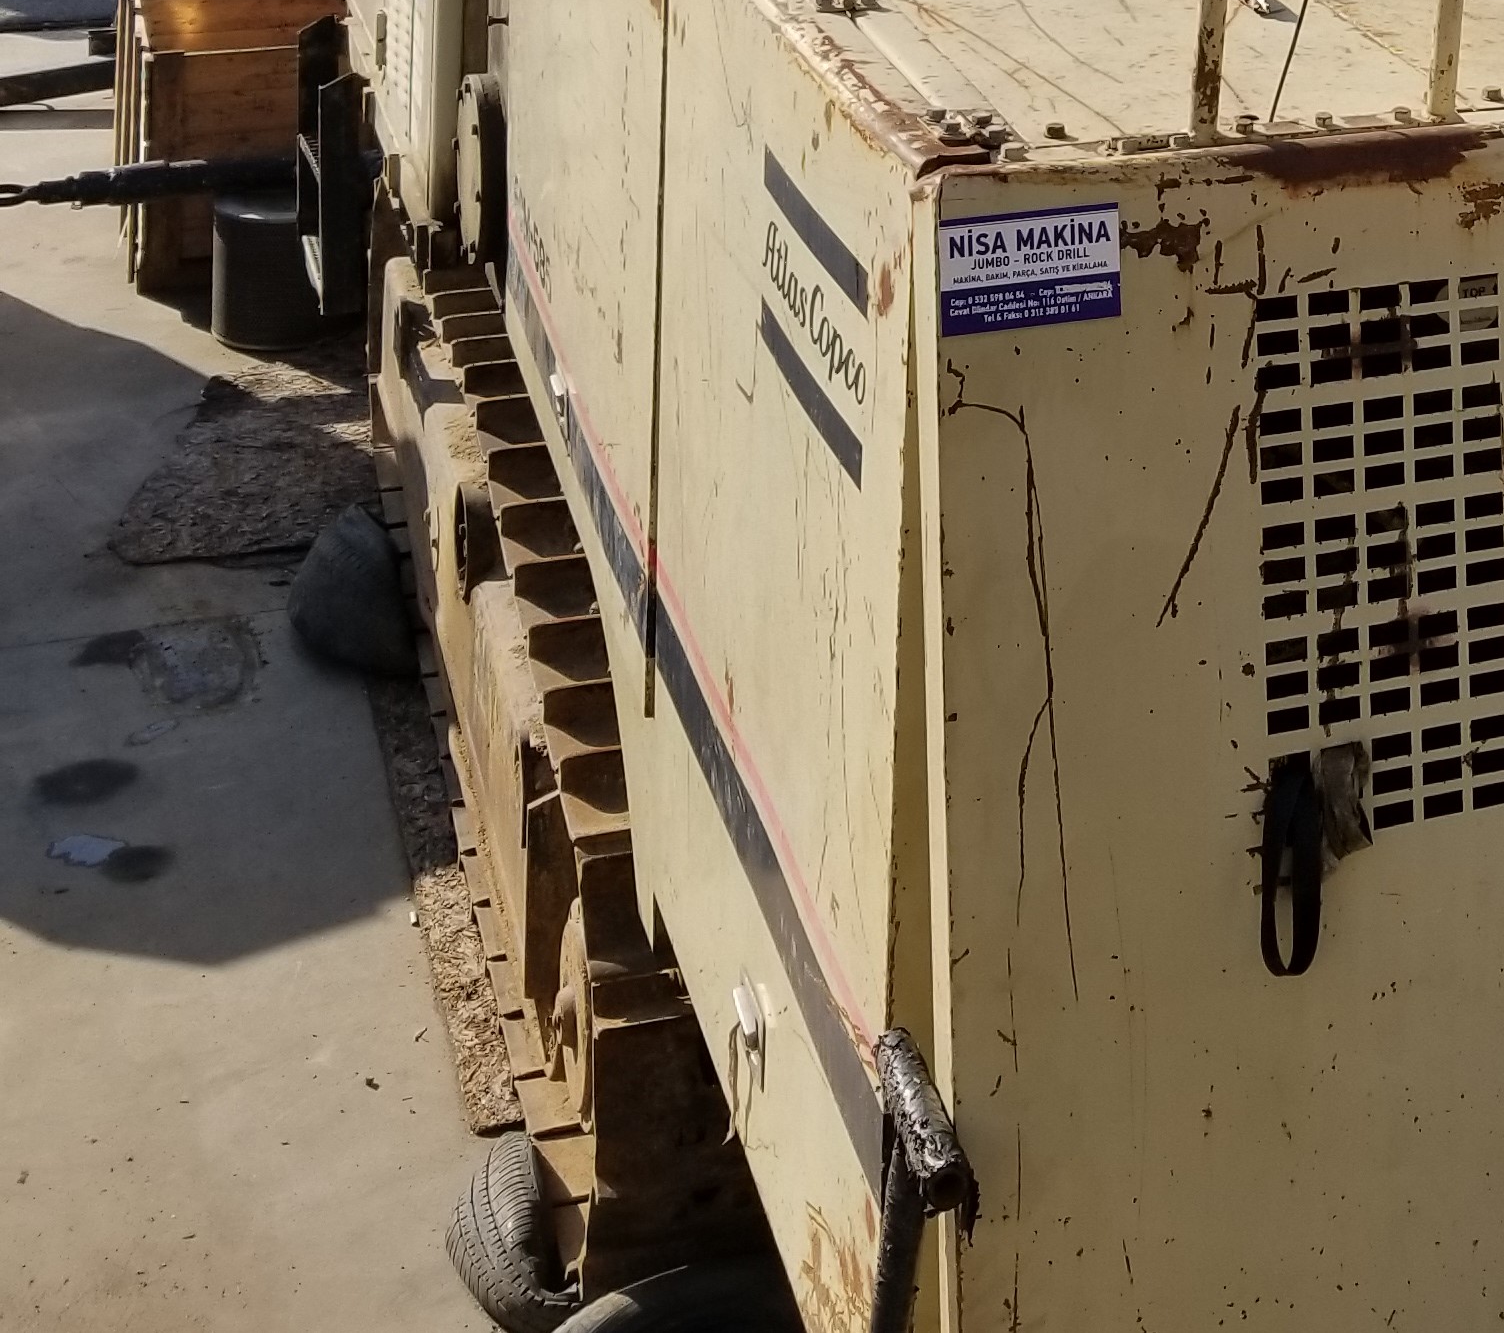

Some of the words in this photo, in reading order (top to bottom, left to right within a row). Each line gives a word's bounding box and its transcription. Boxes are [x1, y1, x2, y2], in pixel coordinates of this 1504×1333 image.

[949, 229, 1008, 259] NİSA
[1016, 218, 1111, 252] MAKİNA
[970, 255, 1010, 271] JUMBO
[1023, 250, 1054, 265] ROCK
[1057, 247, 1090, 261] DRILL
[1012, 268, 1038, 278] PARÇA,
[1039, 266, 1060, 275] SATIŞ
[1061, 264, 1071, 273] VE
[1072, 260, 1108, 272] KİRALAMA
[1042, 296, 1055, 306] 116
[762, 221, 807, 328] Atlas
[809, 285, 867, 405] Copco
[983, 314, 995, 323] Tel
[1030, 308, 1044, 317] 312
[1071, 304, 1080, 312] 61
